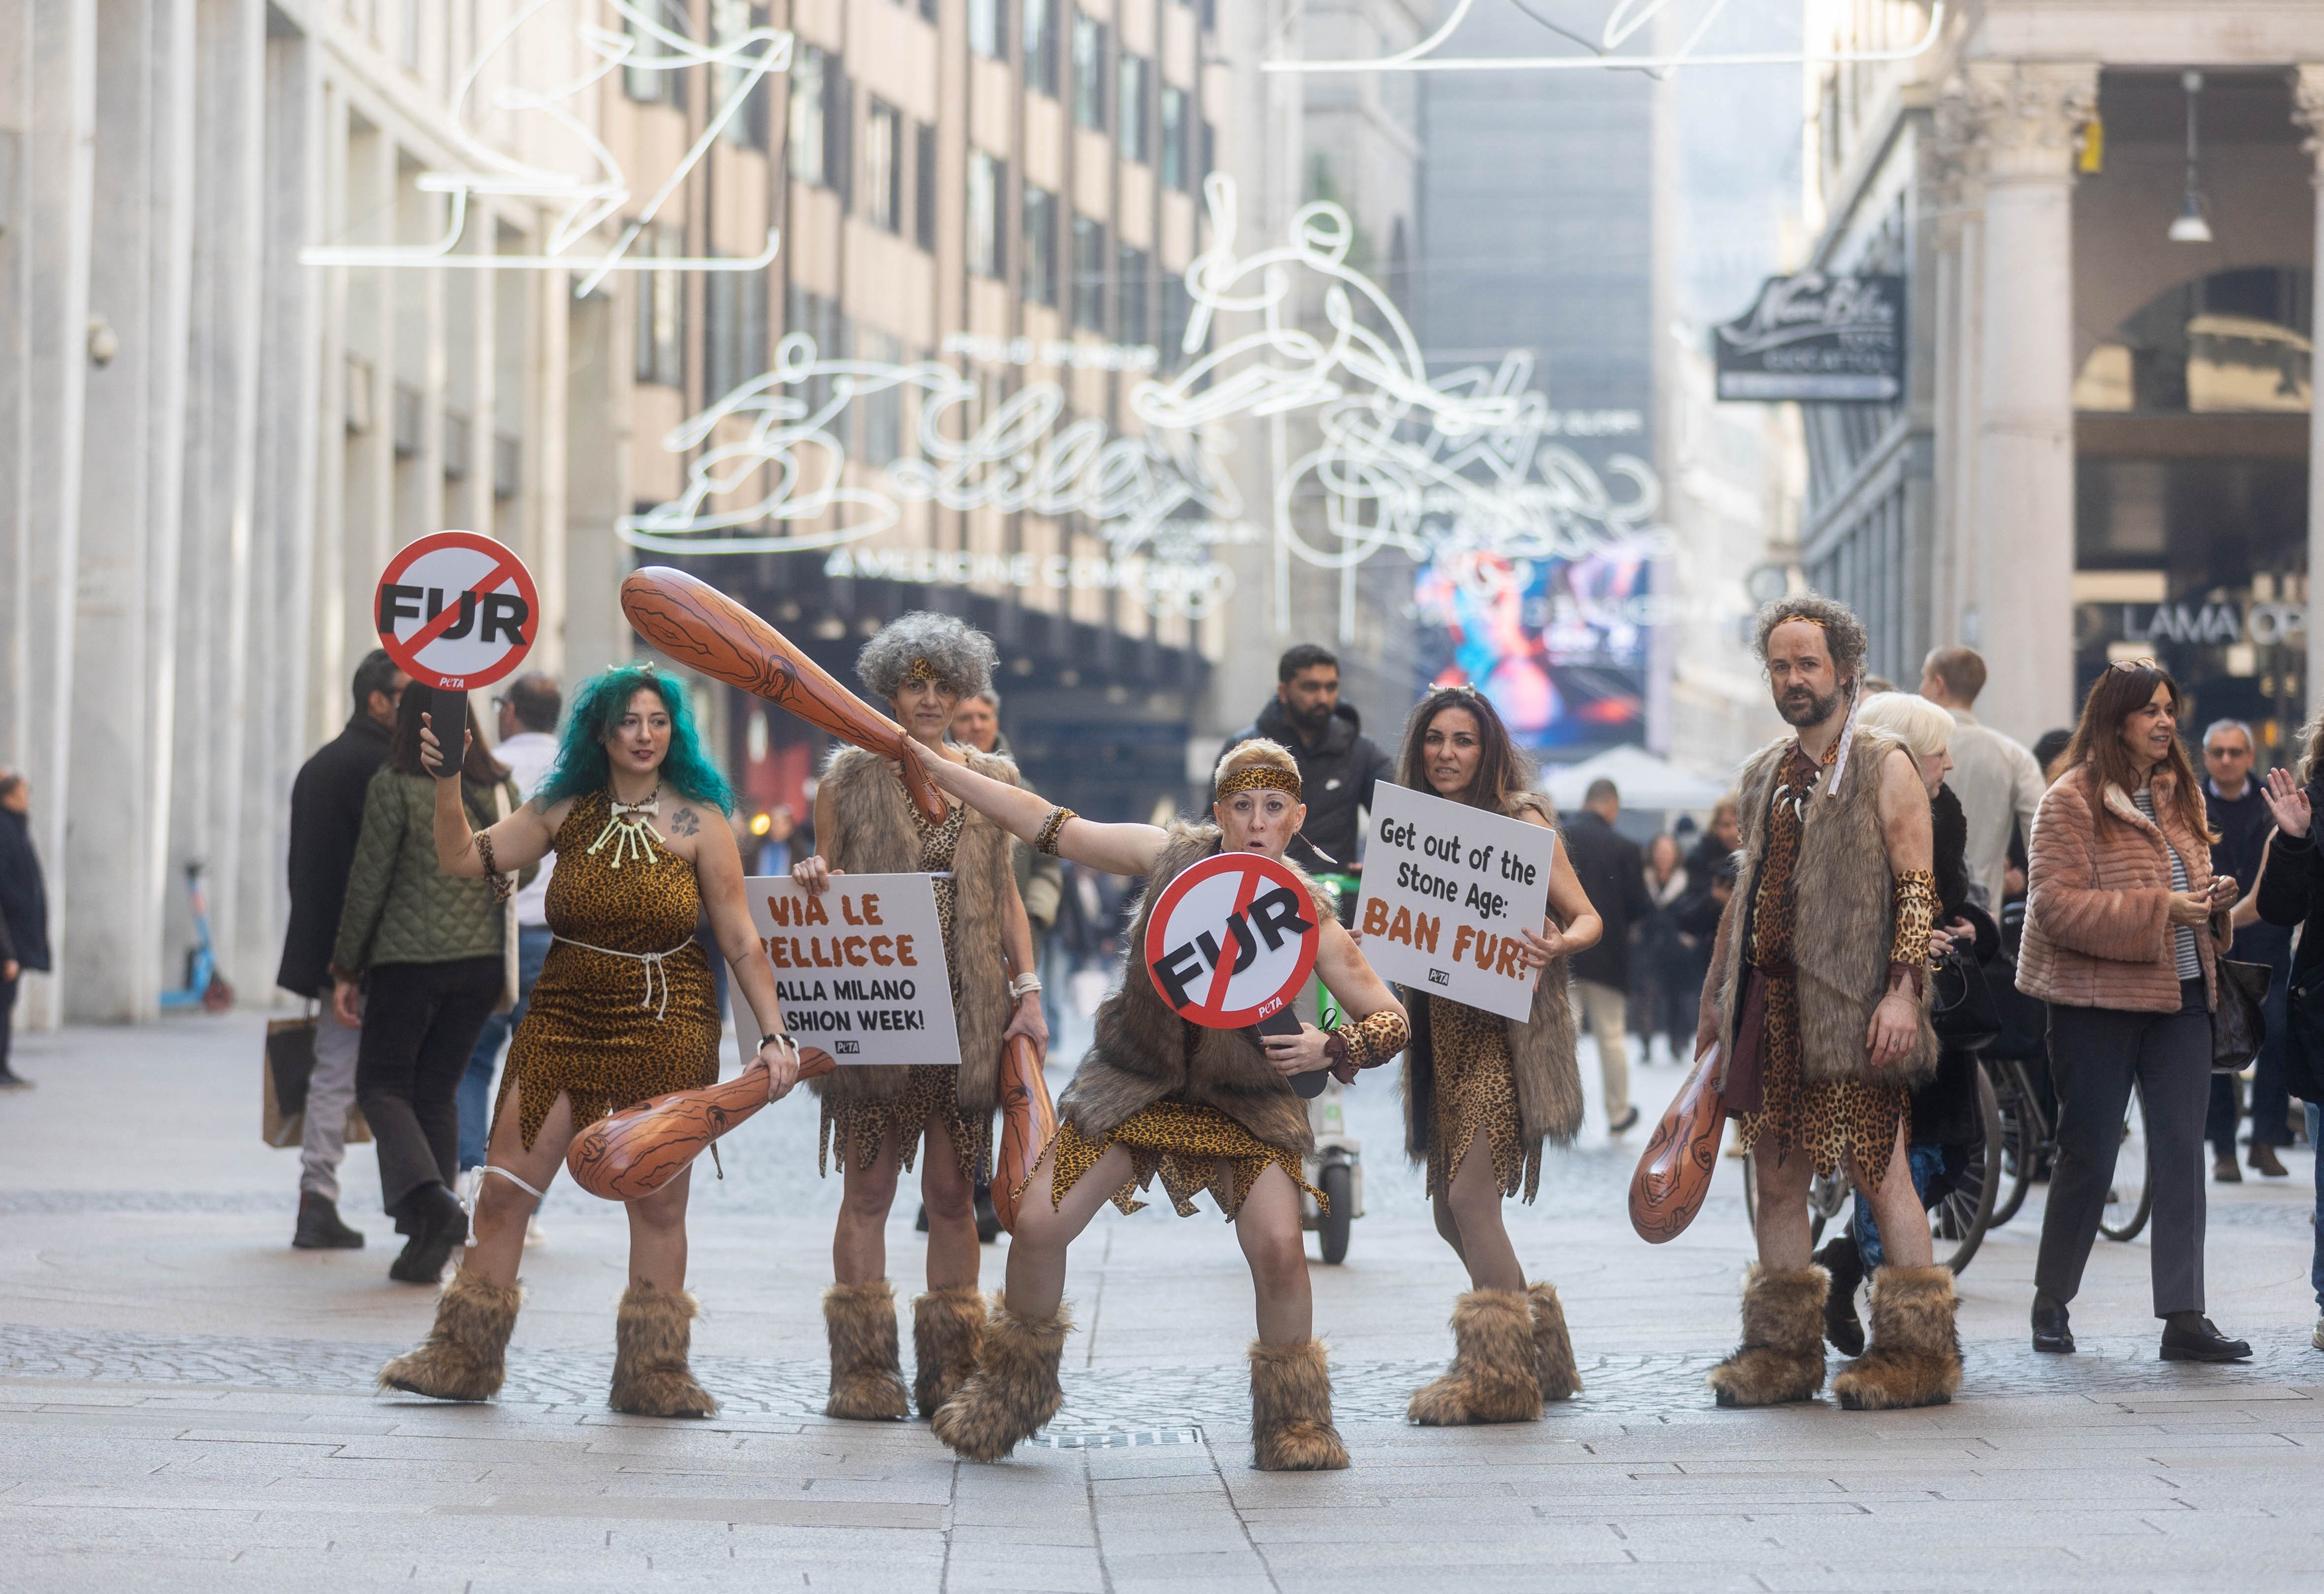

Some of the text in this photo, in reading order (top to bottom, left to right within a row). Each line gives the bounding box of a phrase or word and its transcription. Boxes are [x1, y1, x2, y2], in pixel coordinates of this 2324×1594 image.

[379, 583, 529, 646] FUR
[2123, 603, 2241, 643] LAMA
[1380, 818, 1535, 885] Get out of the
[767, 893, 883, 927] VIA LE
[1397, 862, 1508, 919] Stone Age:
[760, 935, 918, 968] ELLICCE
[1152, 887, 1315, 1011] FUR
[1362, 897, 1529, 980] BAN FUR!
[833, 979, 916, 1001] MILANO
[781, 1009, 924, 1031] SHION WEEK!
